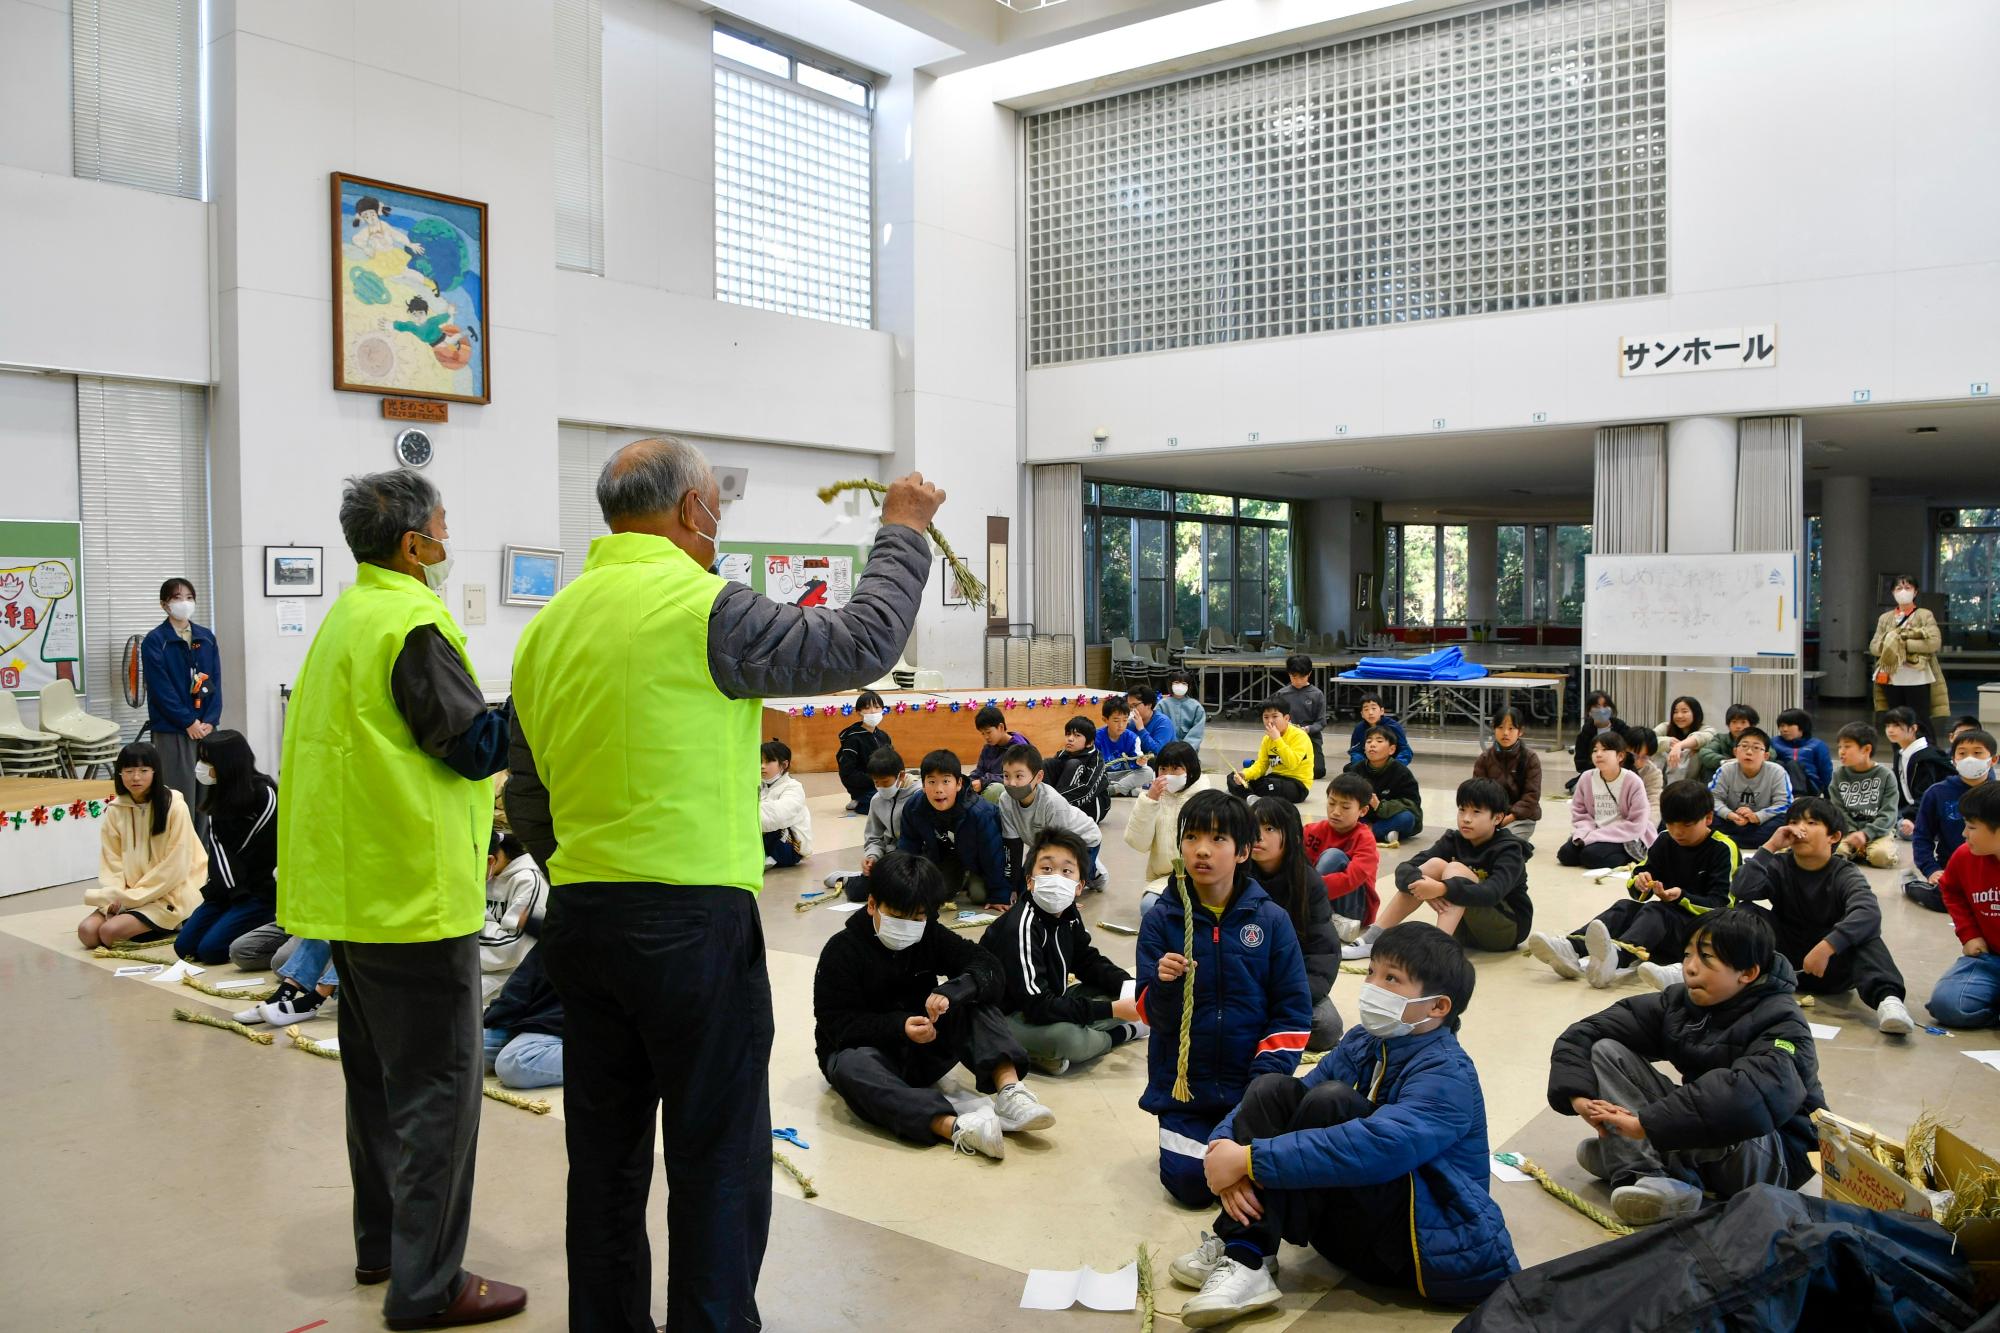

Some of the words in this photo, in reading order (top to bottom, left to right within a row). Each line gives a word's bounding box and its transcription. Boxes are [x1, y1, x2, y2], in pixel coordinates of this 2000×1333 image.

[1623, 334, 1775, 371] サンホール
[1839, 777, 1881, 793] GOOD
